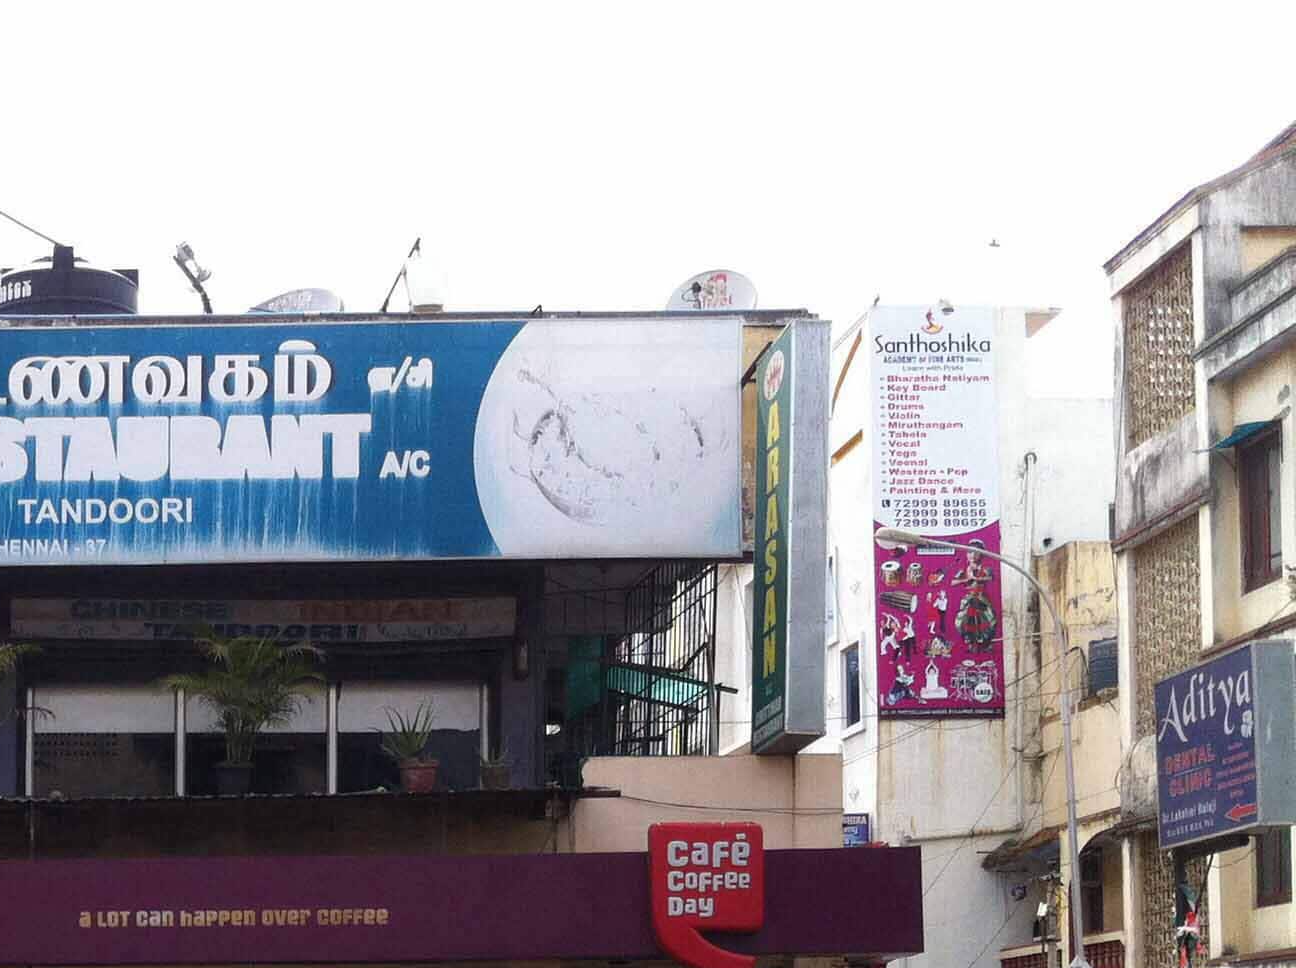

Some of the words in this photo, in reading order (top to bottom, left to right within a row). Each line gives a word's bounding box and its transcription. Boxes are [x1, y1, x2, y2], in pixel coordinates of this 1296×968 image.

[874, 332, 991, 354] Santhoshika
[379, 449, 431, 479] A/C
[18, 498, 193, 525] TANDOORI
[762, 400, 778, 679] ARASAN
[1158, 669, 1252, 743] Aditya
[667, 870, 751, 892] Coffee
[96, 910, 130, 927] LOT
[667, 896, 715, 917] Day
